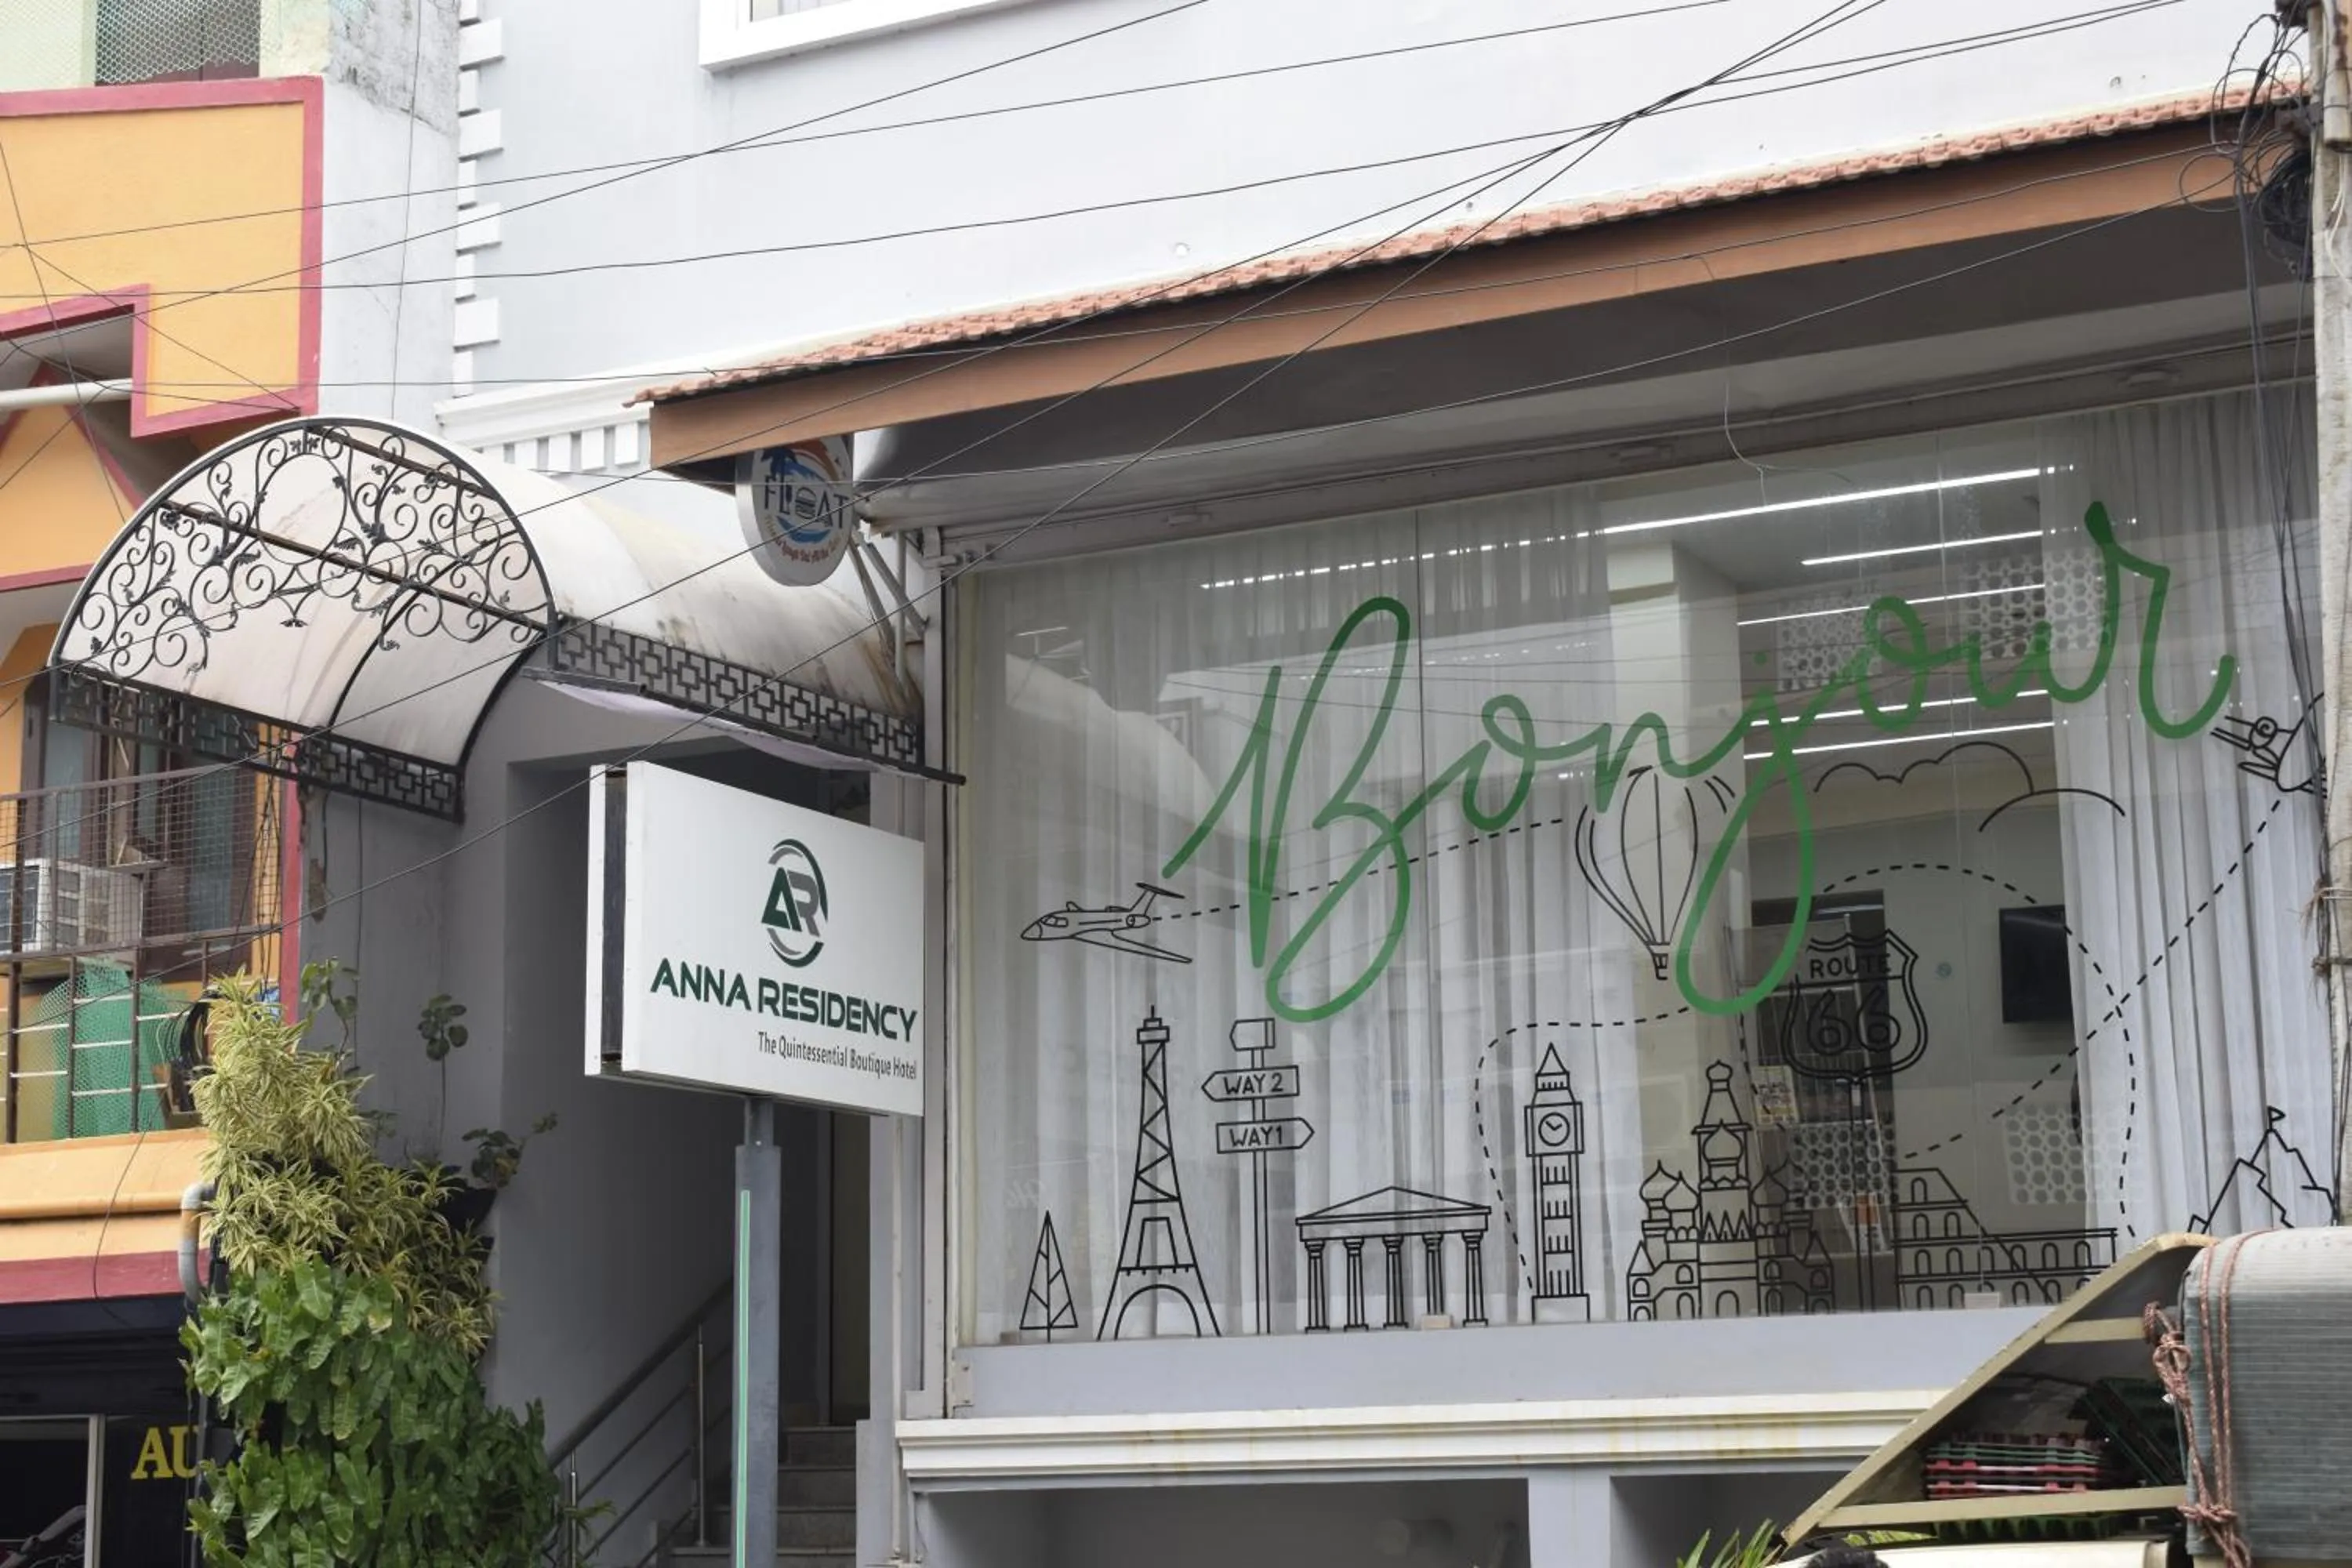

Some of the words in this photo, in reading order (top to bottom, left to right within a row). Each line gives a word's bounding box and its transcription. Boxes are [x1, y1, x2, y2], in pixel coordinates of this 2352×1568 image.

[764, 474, 849, 529] FLOAT
[1163, 502, 2234, 1022] Bonjour
[761, 867, 819, 937] AR
[1810, 953, 1890, 978] ROUTE
[651, 958, 750, 1010] ANNA
[759, 978, 917, 1042] RESIDENCY
[1808, 986, 1900, 1054] 66
[758, 1032, 776, 1054] The
[779, 1036, 848, 1067] Quintessential
[850, 1049, 891, 1080] Boutique
[1223, 1073, 1265, 1094] WAY
[1271, 1073, 1283, 1093] 2
